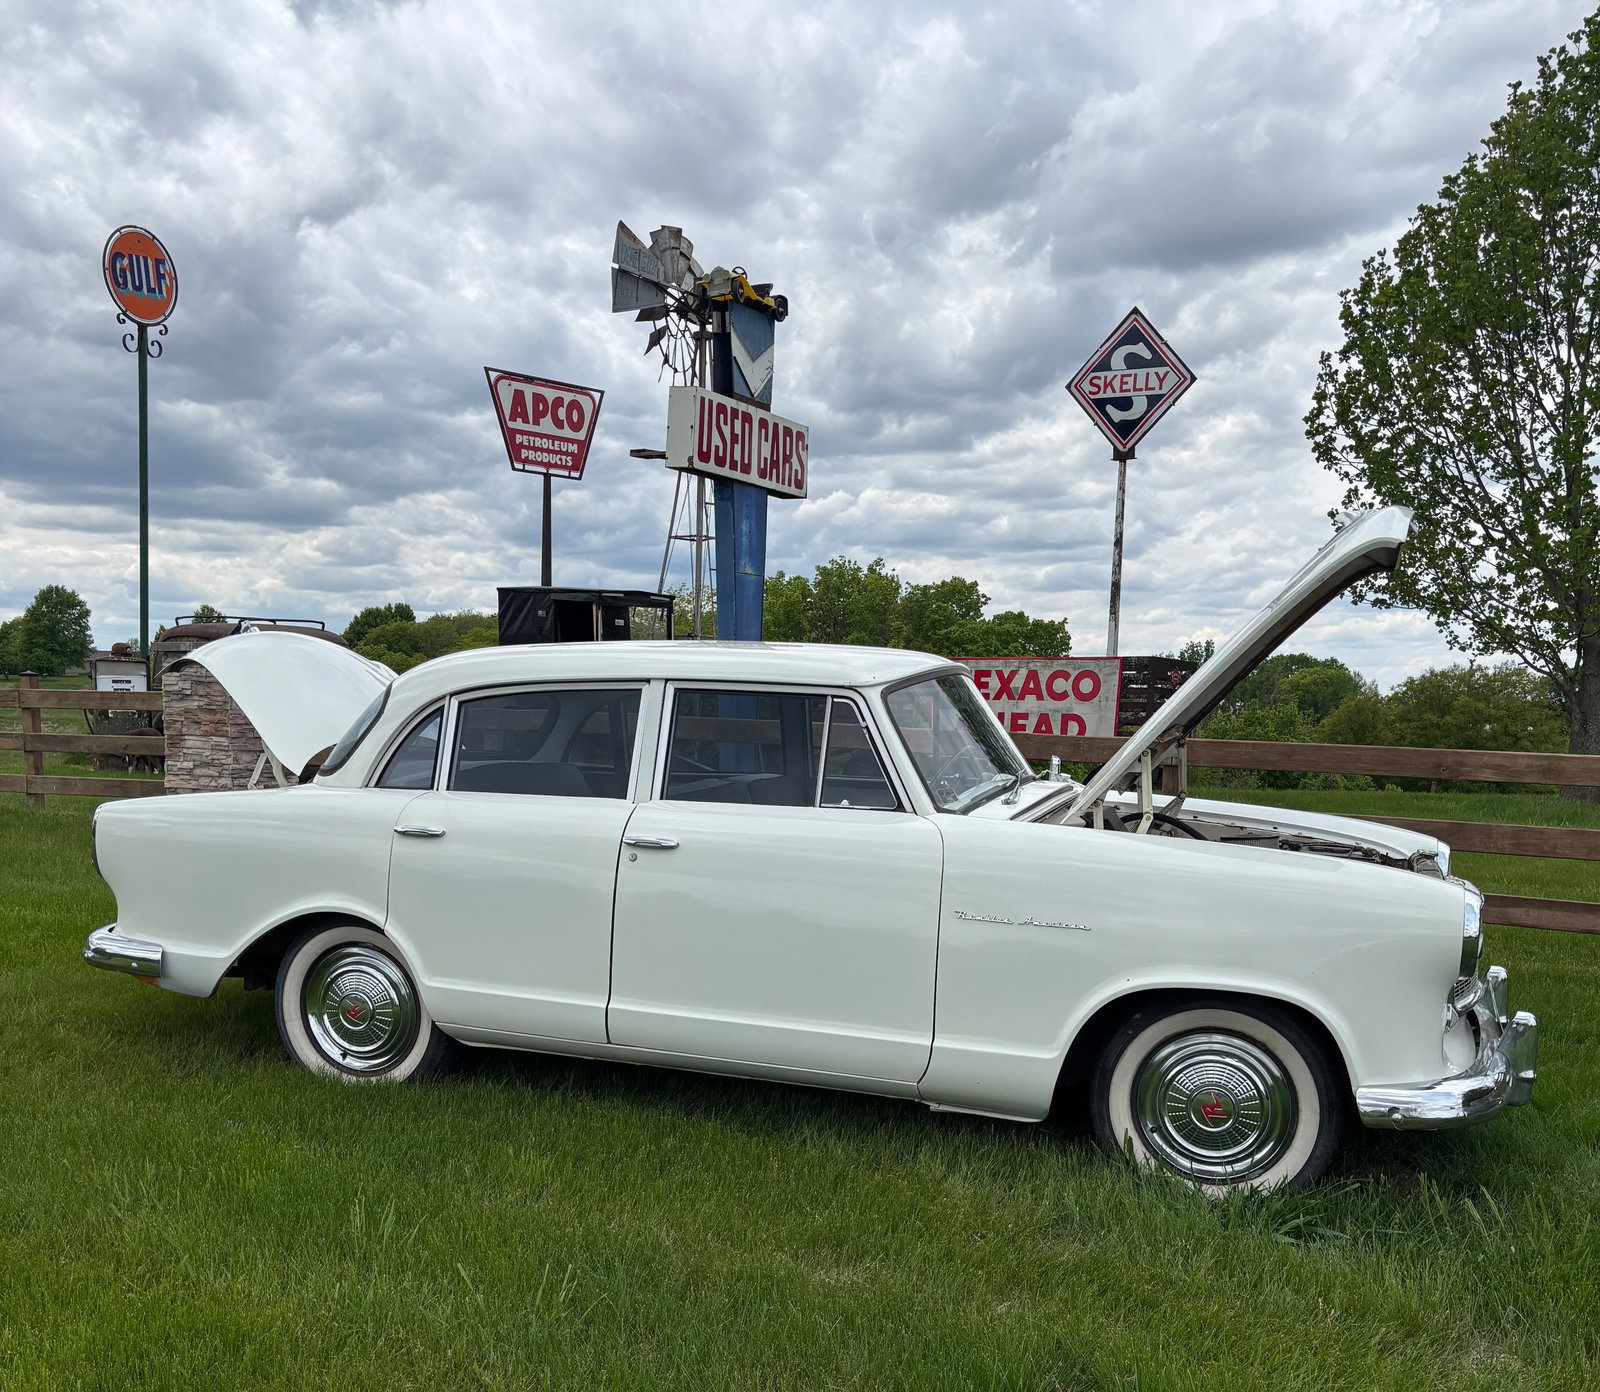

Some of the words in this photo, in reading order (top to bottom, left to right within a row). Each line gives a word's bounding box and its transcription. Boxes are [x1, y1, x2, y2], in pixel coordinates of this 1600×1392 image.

[111, 251, 168, 298] GULF
[1088, 370, 1170, 396] SKELLY
[508, 388, 585, 433] APCO
[515, 433, 578, 454] PETROLEUM
[521, 449, 573, 467] PRODUCTS
[697, 396, 753, 475] USED
[757, 417, 806, 491] CARS
[971, 669, 1101, 702] EXACO
